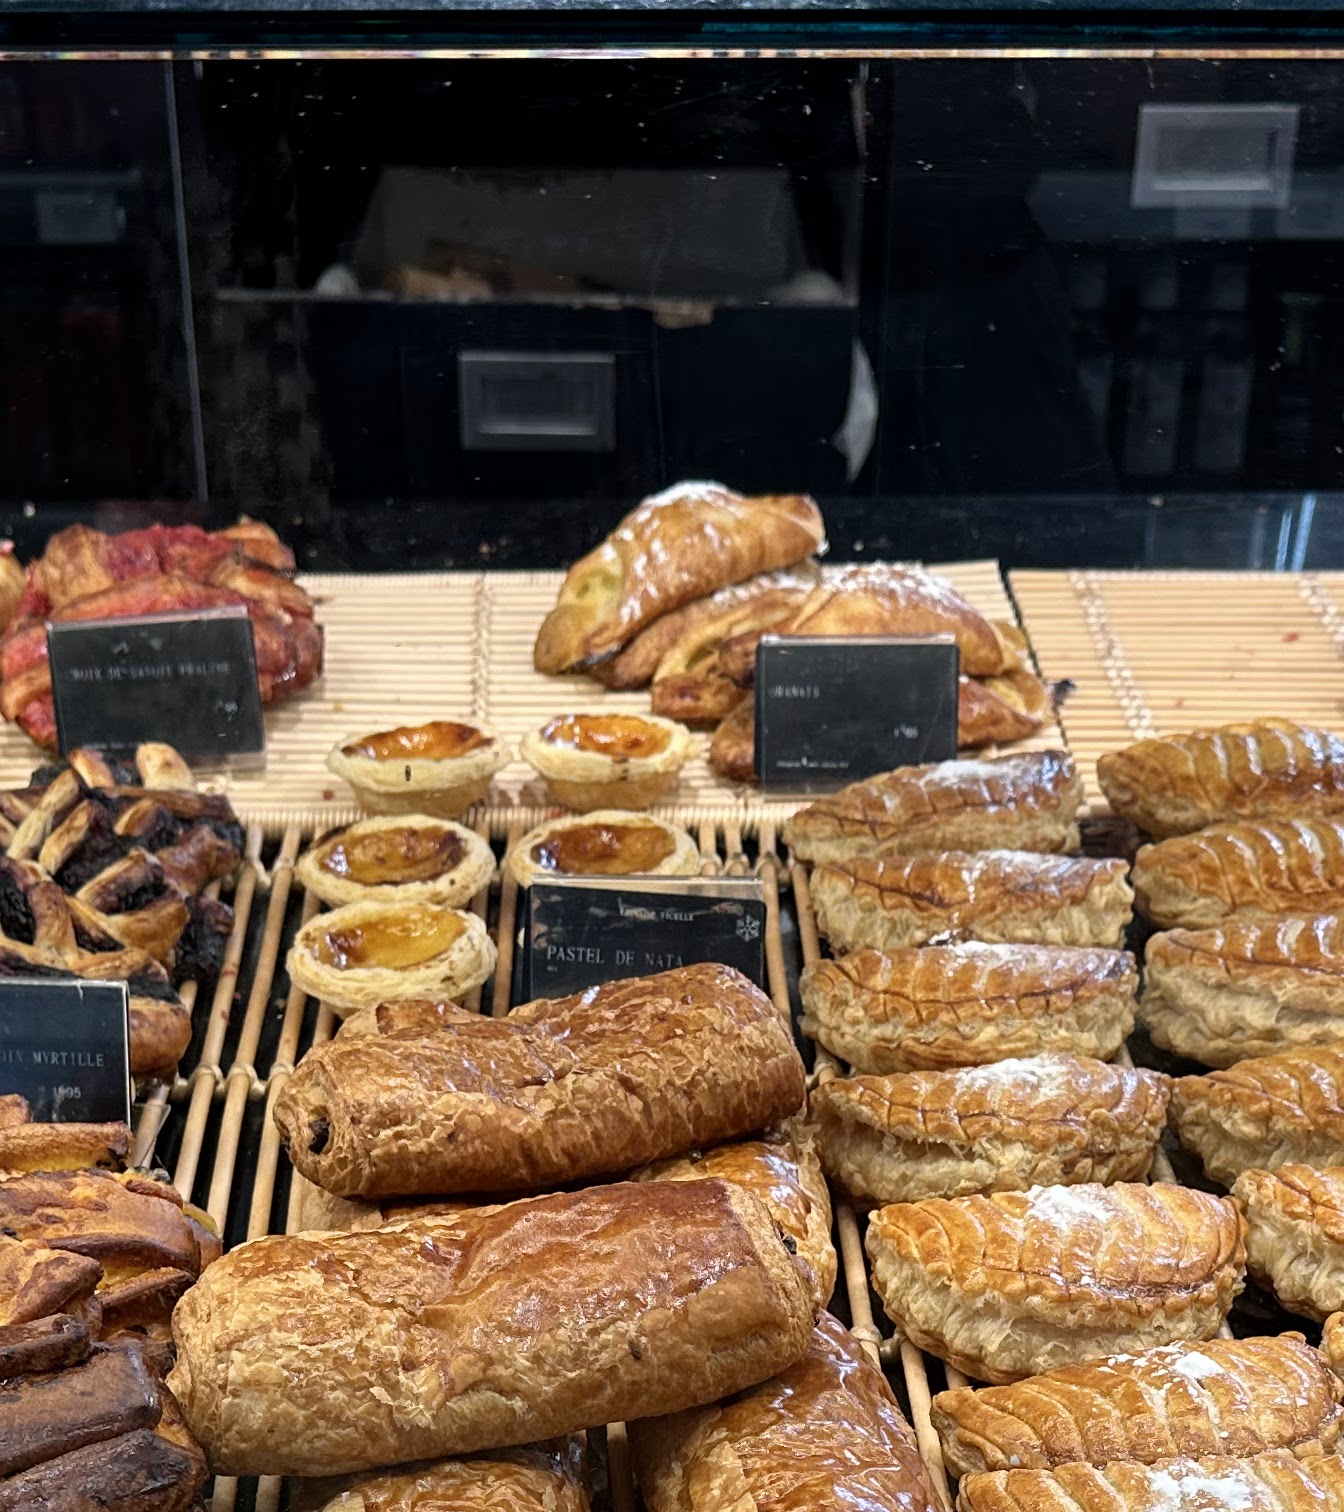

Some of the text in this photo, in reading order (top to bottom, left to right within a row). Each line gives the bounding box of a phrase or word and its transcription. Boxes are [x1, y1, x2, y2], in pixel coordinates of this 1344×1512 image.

[546, 945, 684, 968] PASTEL DE NATA
[31, 1050, 105, 1067] MYRTILLE
